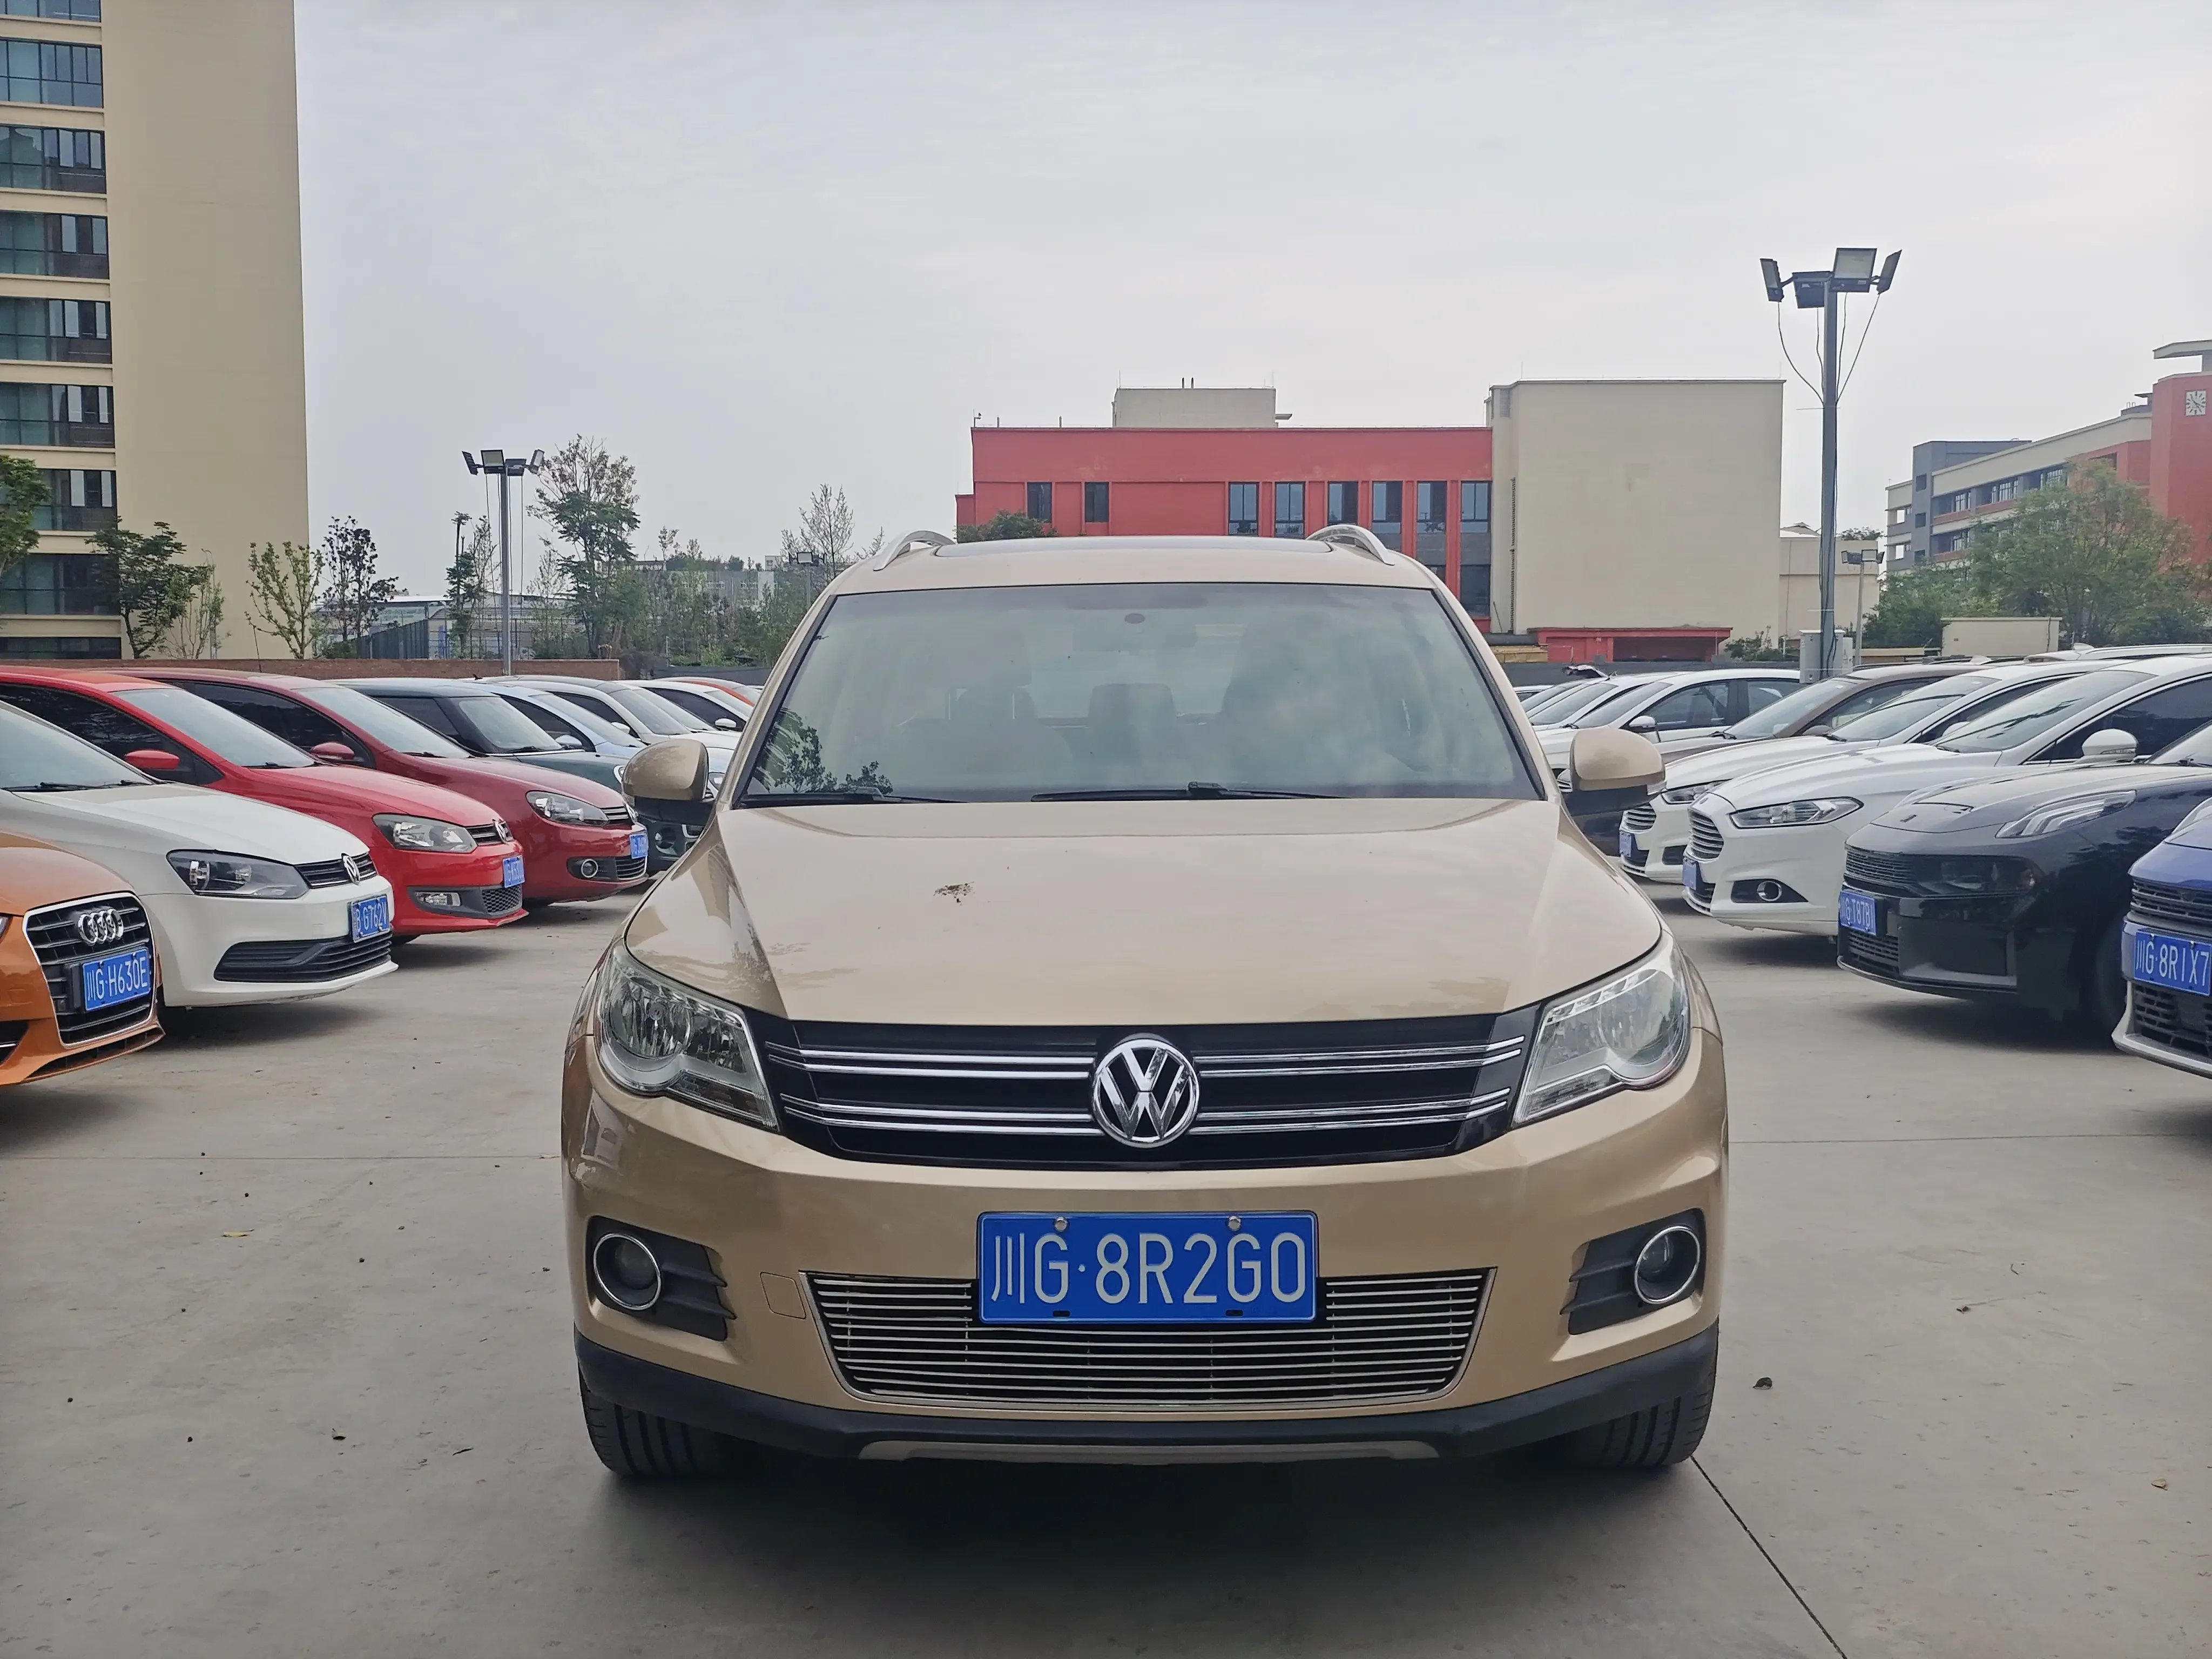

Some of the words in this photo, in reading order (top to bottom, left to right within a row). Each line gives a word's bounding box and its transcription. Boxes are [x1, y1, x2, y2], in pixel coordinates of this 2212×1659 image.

[86, 956, 147, 1001] 川G·H630E
[2136, 940, 2209, 986] 川G·8R1X7
[1093, 1038, 1199, 1148] VW
[992, 1232, 1306, 1304] 川G·8R2G0
